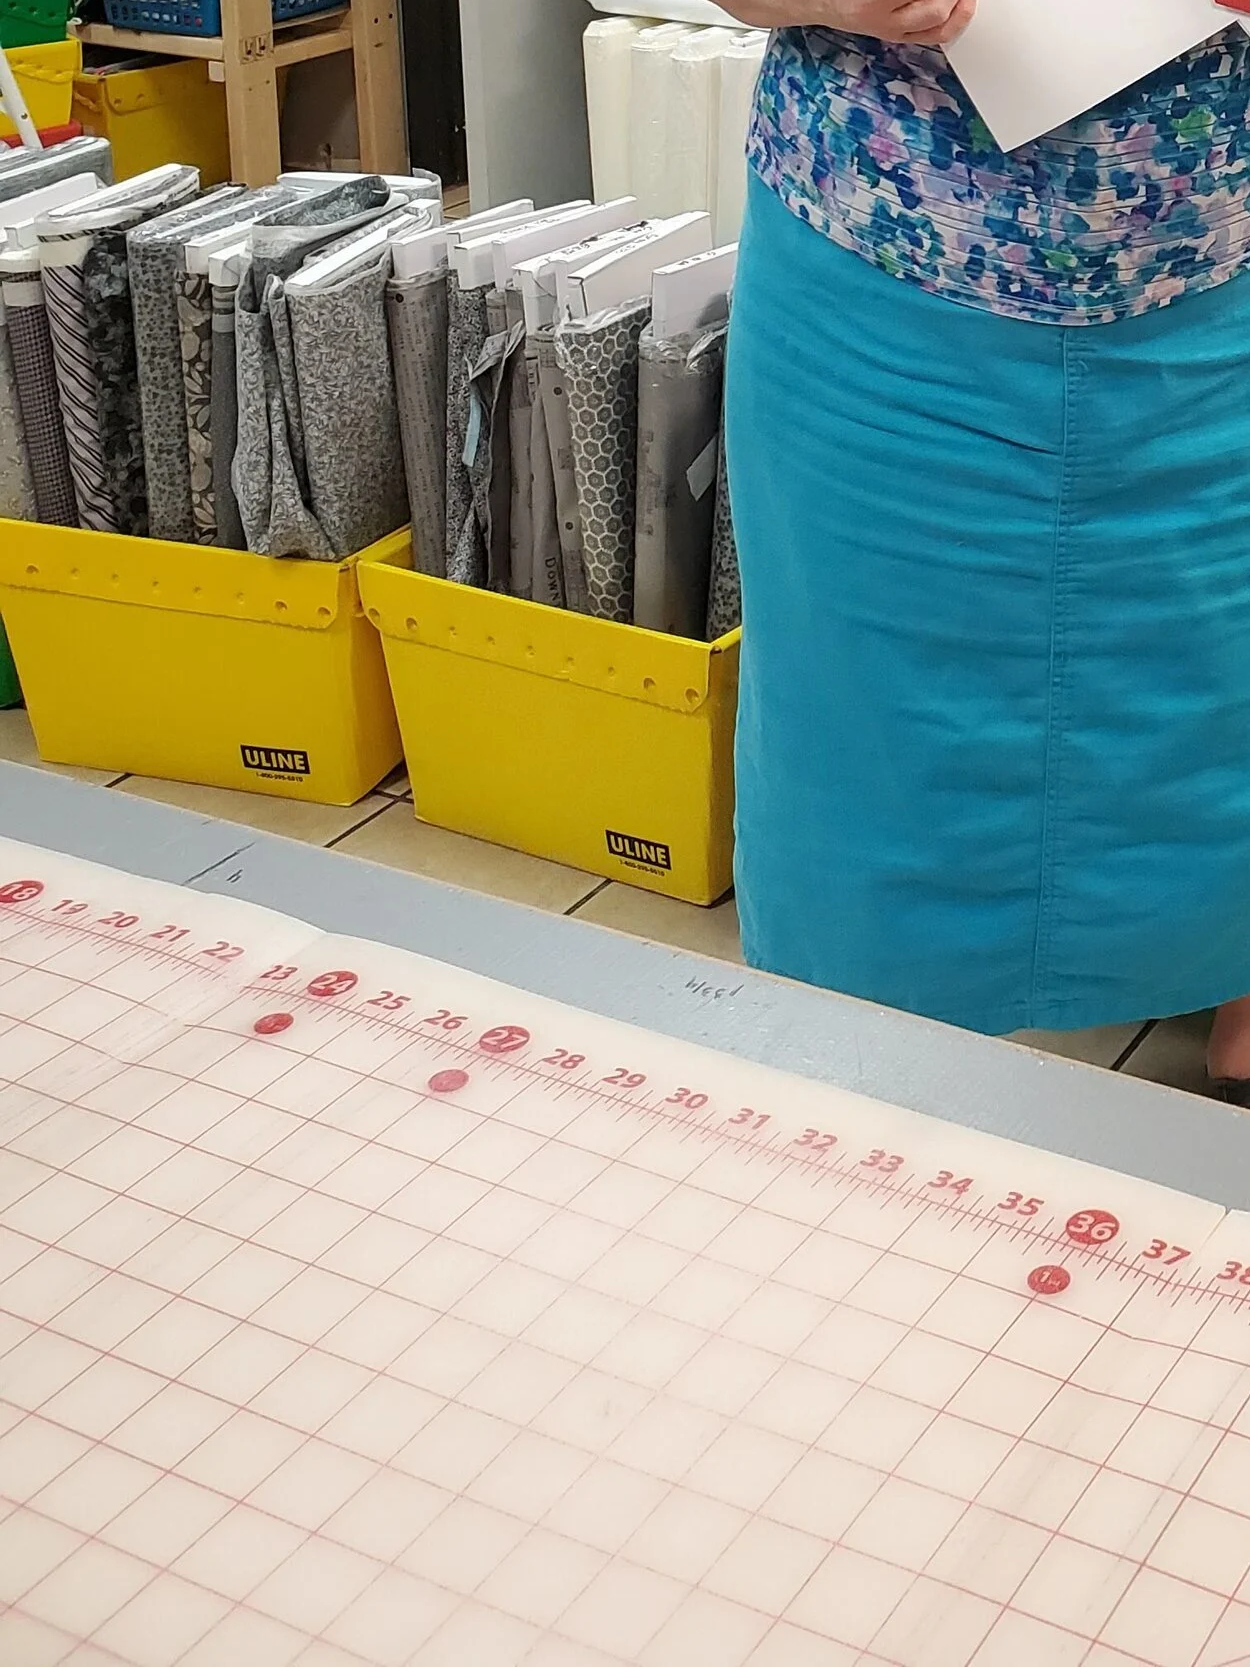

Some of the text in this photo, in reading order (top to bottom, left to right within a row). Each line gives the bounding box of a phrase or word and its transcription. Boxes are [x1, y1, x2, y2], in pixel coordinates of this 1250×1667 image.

[244, 748, 307, 772] ULINE
[609, 833, 669, 866] ULINE
[1, 882, 38, 901] 18
[51, 899, 89, 916] 19
[98, 911, 140, 928] 20
[152, 924, 191, 942] 21
[202, 941, 245, 963] 22
[260, 964, 298, 981] 23
[311, 973, 357, 993] 24
[367, 990, 411, 1010] 25
[424, 1009, 468, 1031] 26
[482, 1028, 526, 1049] 27
[543, 1048, 586, 1070] 28
[601, 1067, 647, 1089] 29
[664, 1087, 709, 1110] 30
[728, 1107, 771, 1130] 31
[793, 1128, 838, 1151] 32
[859, 1148, 905, 1174] 33
[927, 1170, 975, 1195] 34
[997, 1191, 1045, 1217] 35
[1067, 1212, 1117, 1242] 36
[1142, 1238, 1191, 1266] 37
